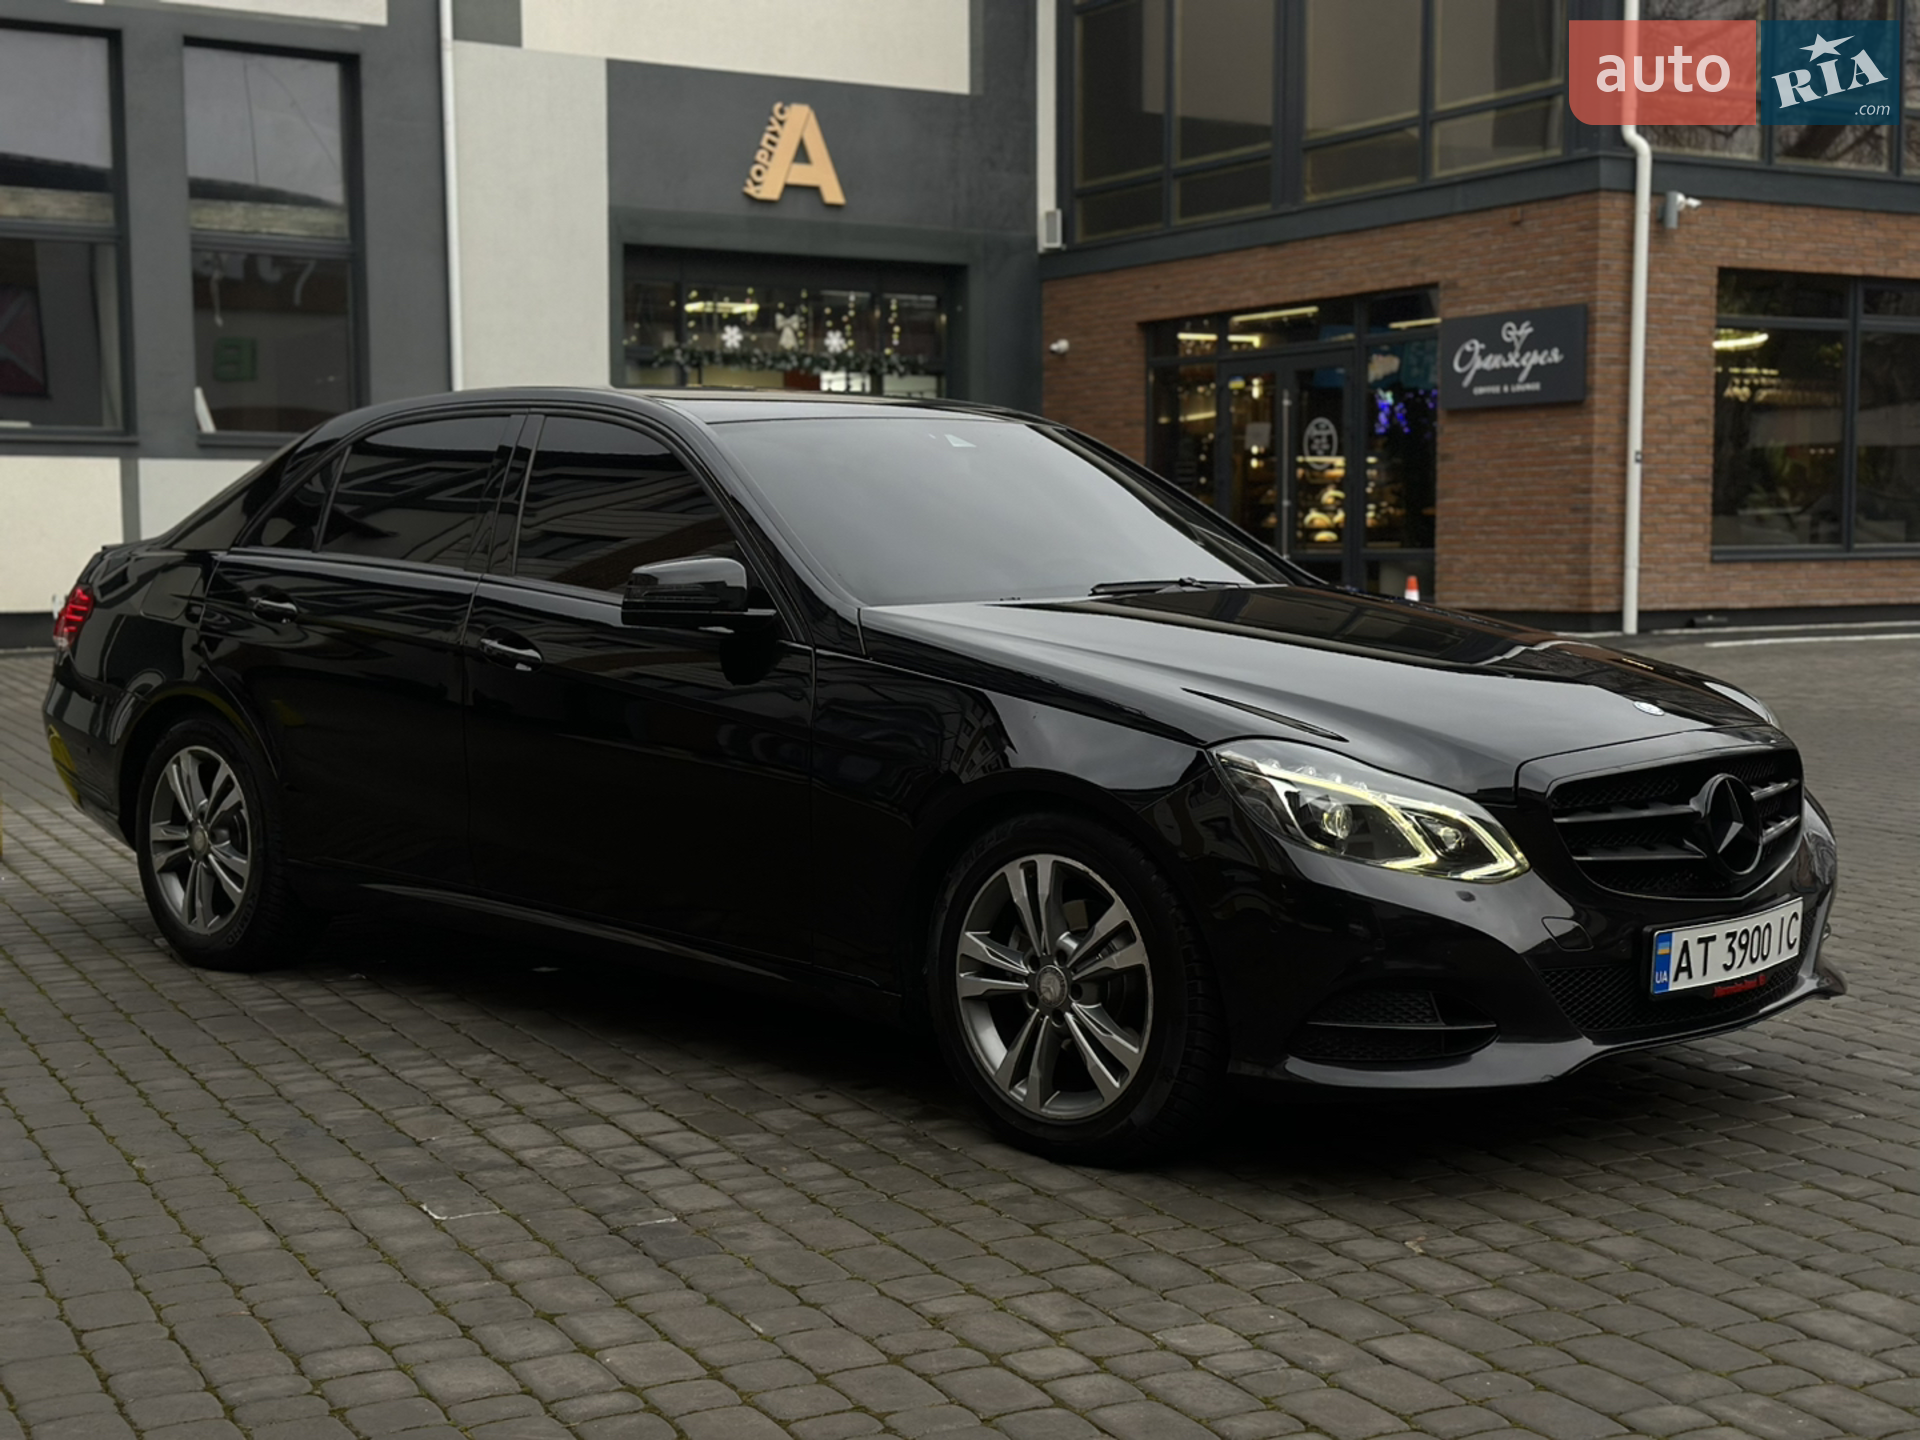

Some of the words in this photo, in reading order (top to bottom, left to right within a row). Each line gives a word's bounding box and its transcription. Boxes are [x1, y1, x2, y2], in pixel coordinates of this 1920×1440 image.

[1673, 934, 1717, 982] AT
[1722, 922, 1772, 971] 3900
[1777, 911, 1799, 956] IC
[1655, 971, 1668, 984] UA
